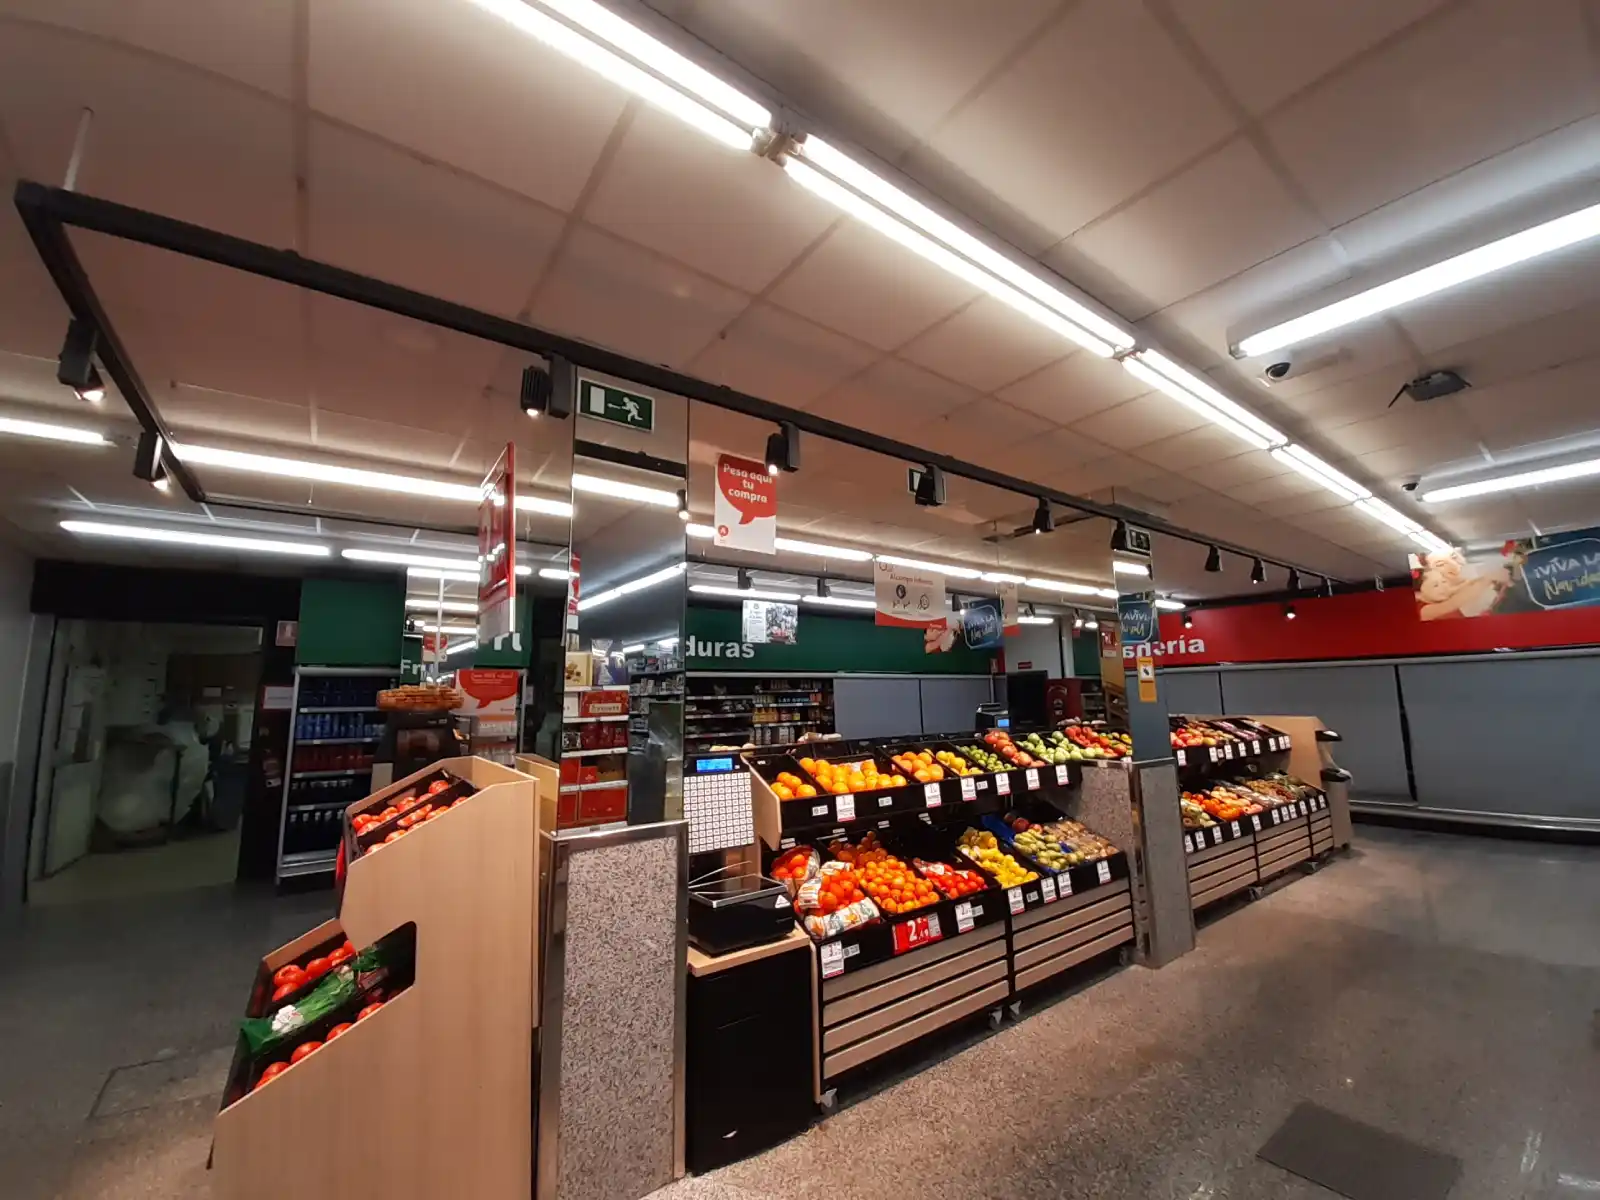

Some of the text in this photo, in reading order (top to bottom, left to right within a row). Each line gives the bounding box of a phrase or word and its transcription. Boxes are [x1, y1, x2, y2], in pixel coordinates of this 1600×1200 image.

[723, 464, 747, 477] Pesa
[742, 479, 754, 490] tu
[728, 488, 768, 503] compra
